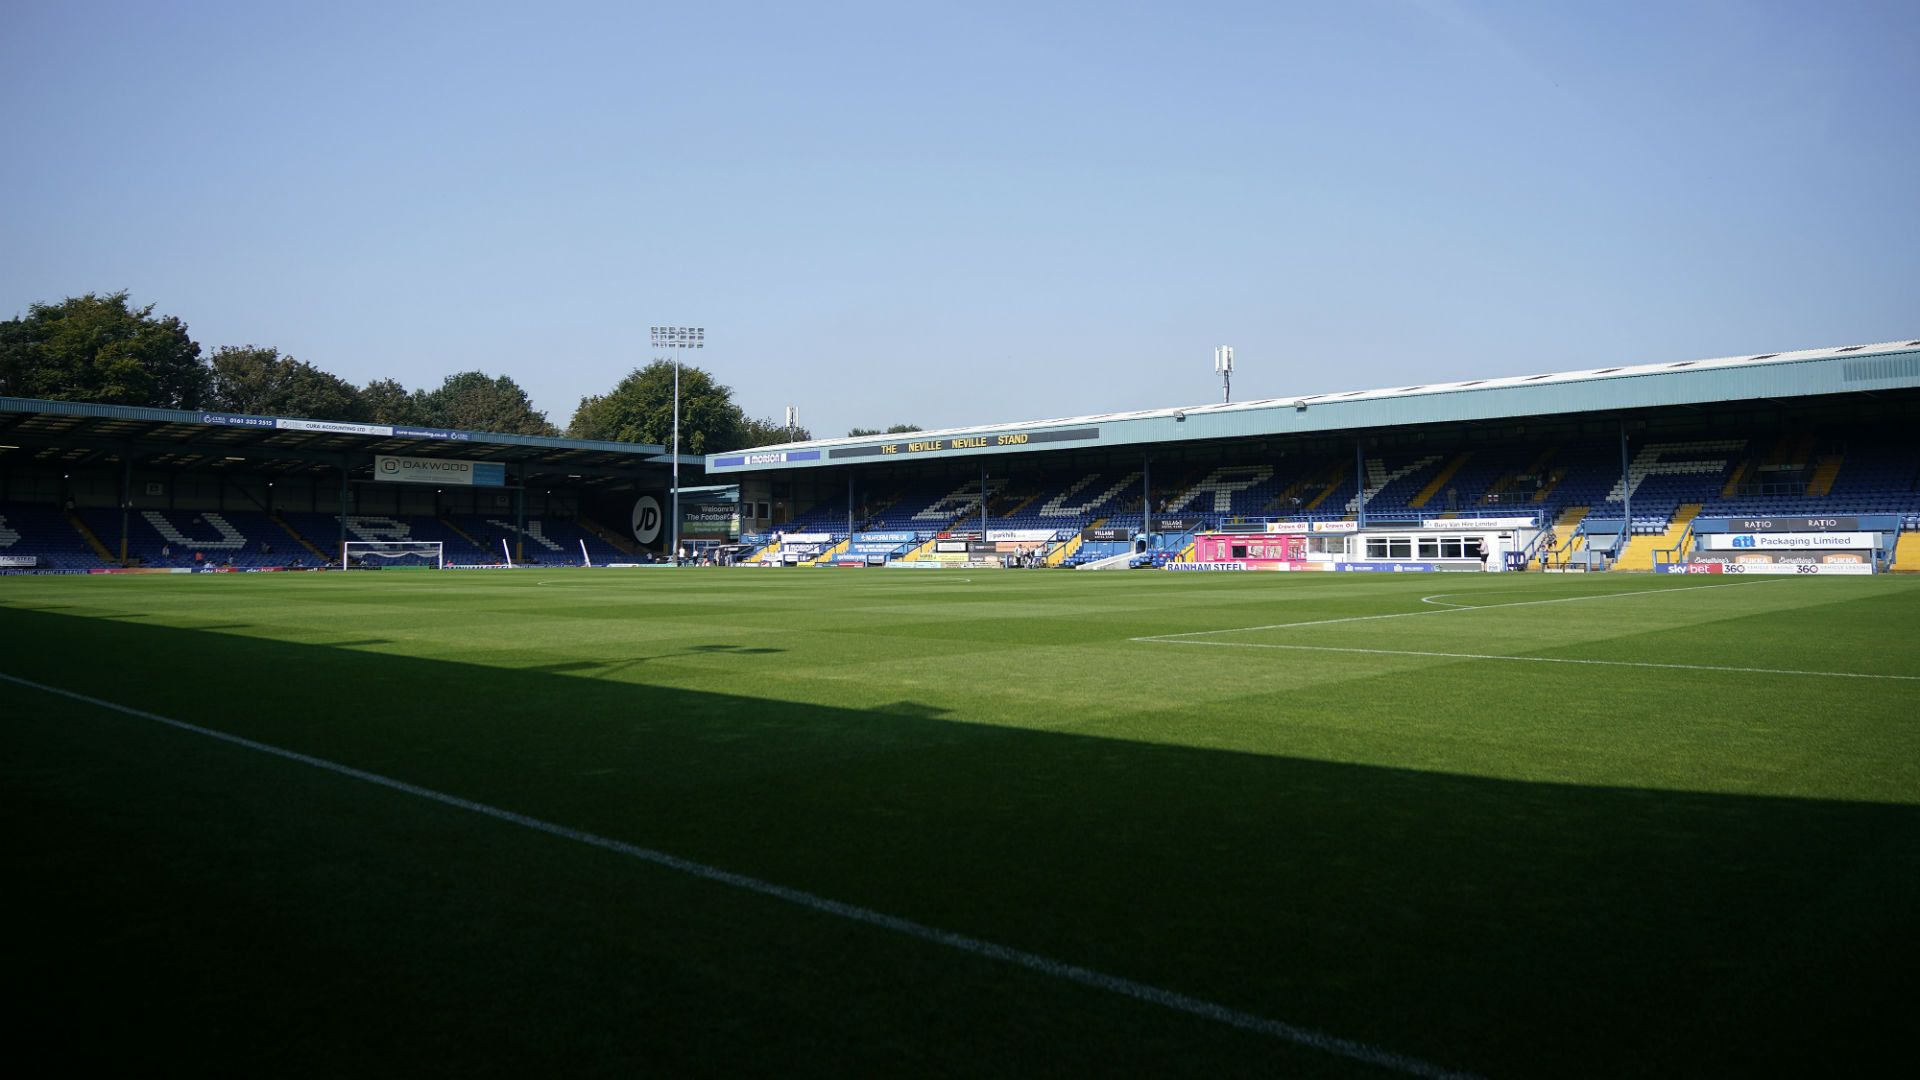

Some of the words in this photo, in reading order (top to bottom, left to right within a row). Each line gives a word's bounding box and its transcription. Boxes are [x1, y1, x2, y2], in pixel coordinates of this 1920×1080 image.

[881, 444, 897, 454] THE
[908, 440, 942, 452] NEVILLE
[951, 436, 987, 449] NEVILLE
[997, 434, 1028, 445] STAND
[402, 459, 469, 472] OAKWOOD
[636, 506, 658, 531] JD
[687, 513, 700, 521] The
[1808, 519, 1837, 527] RATIO
[1760, 537, 1811, 547] Packaging
[1813, 536, 1851, 545] Limited
[1167, 563, 1212, 571] RAINHAM
[1668, 565, 1687, 573] sky
[1689, 565, 1710, 573] bet
[1724, 565, 1746, 573] 360
[1796, 565, 1819, 573] 360
